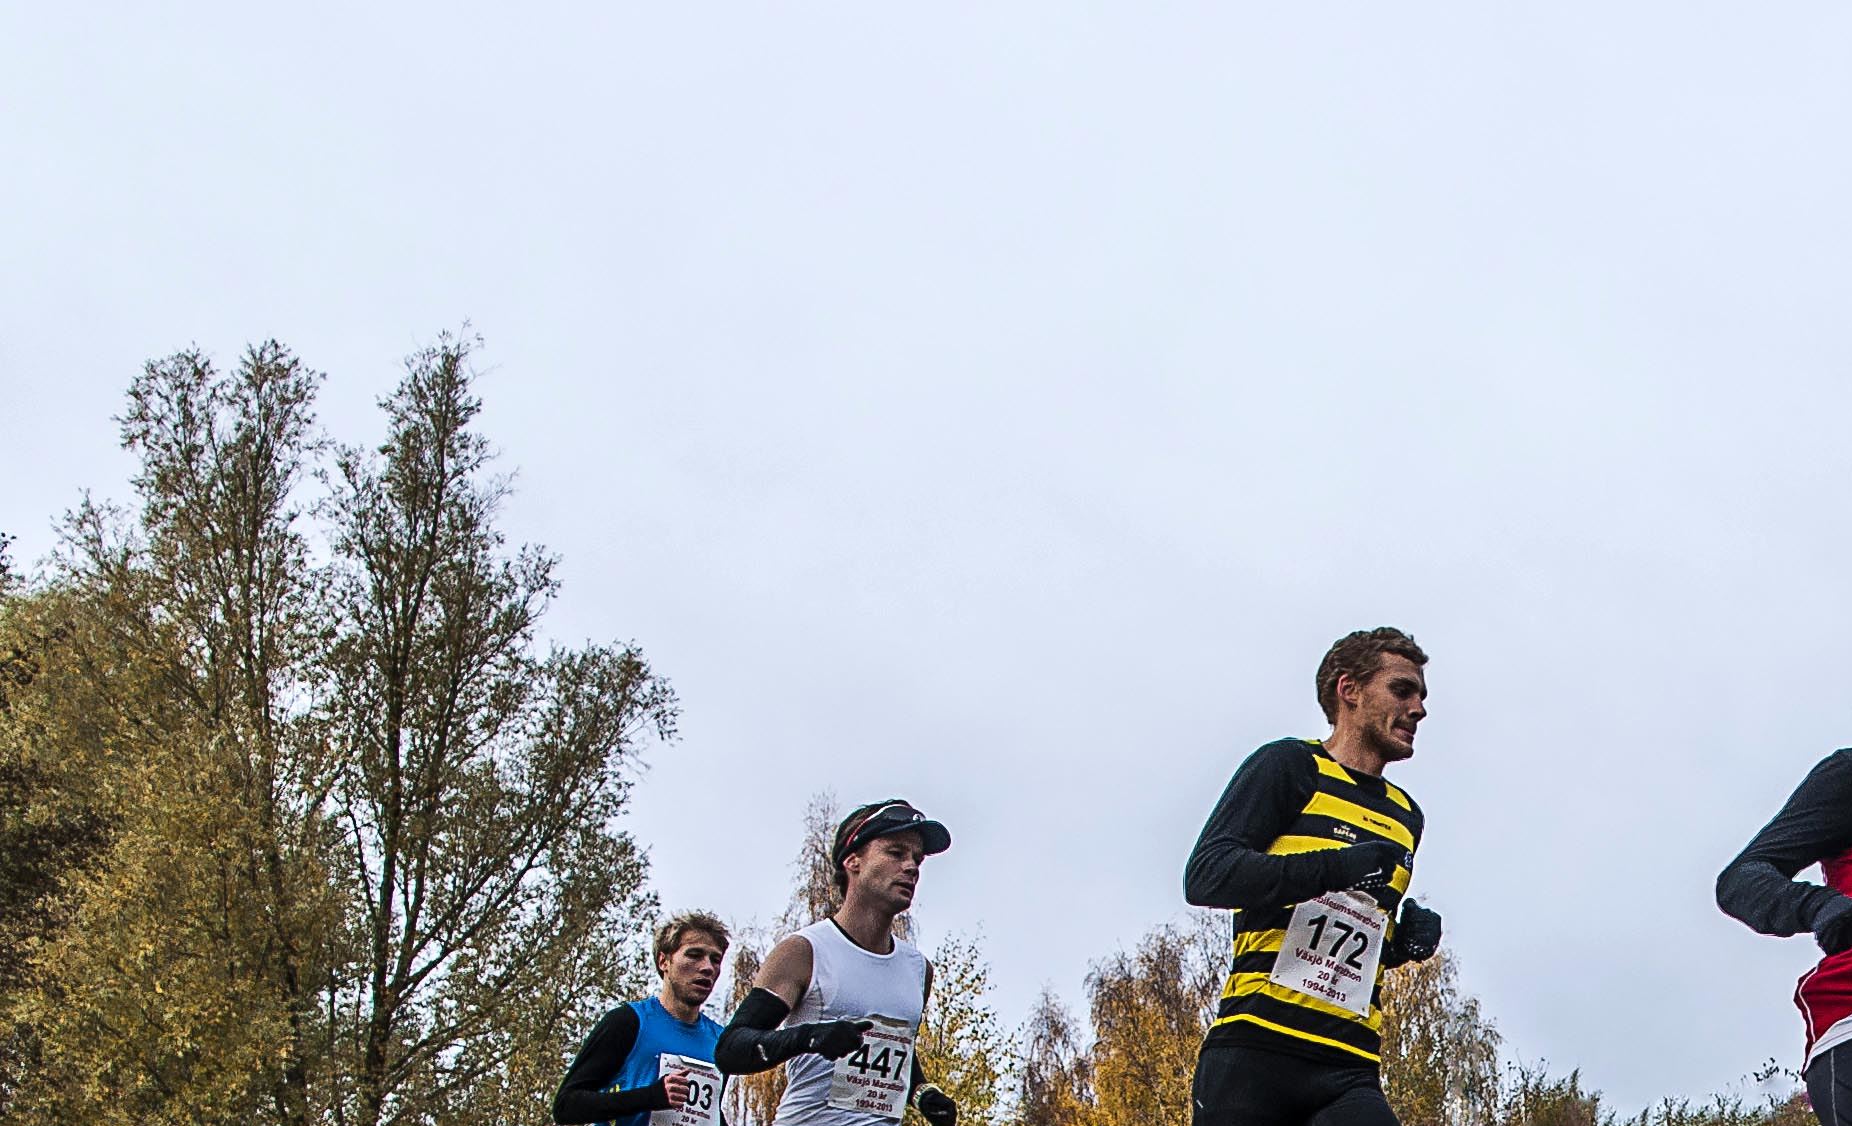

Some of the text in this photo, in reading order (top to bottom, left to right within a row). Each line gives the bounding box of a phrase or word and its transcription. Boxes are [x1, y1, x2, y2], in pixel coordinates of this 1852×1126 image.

[1313, 897, 1381, 931] bileumsmarathon
[1308, 914, 1369, 970] 172
[1295, 947, 1362, 983] Växjö Marathon
[1317, 970, 1330, 982] 20
[1302, 978, 1346, 1002] 1994-2013
[848, 1043, 907, 1080] 447
[846, 1074, 870, 1088] Växjö
[866, 1089, 878, 1098] 20
[686, 1080, 713, 1110] 03
[855, 1099, 893, 1113] 1994-2013
